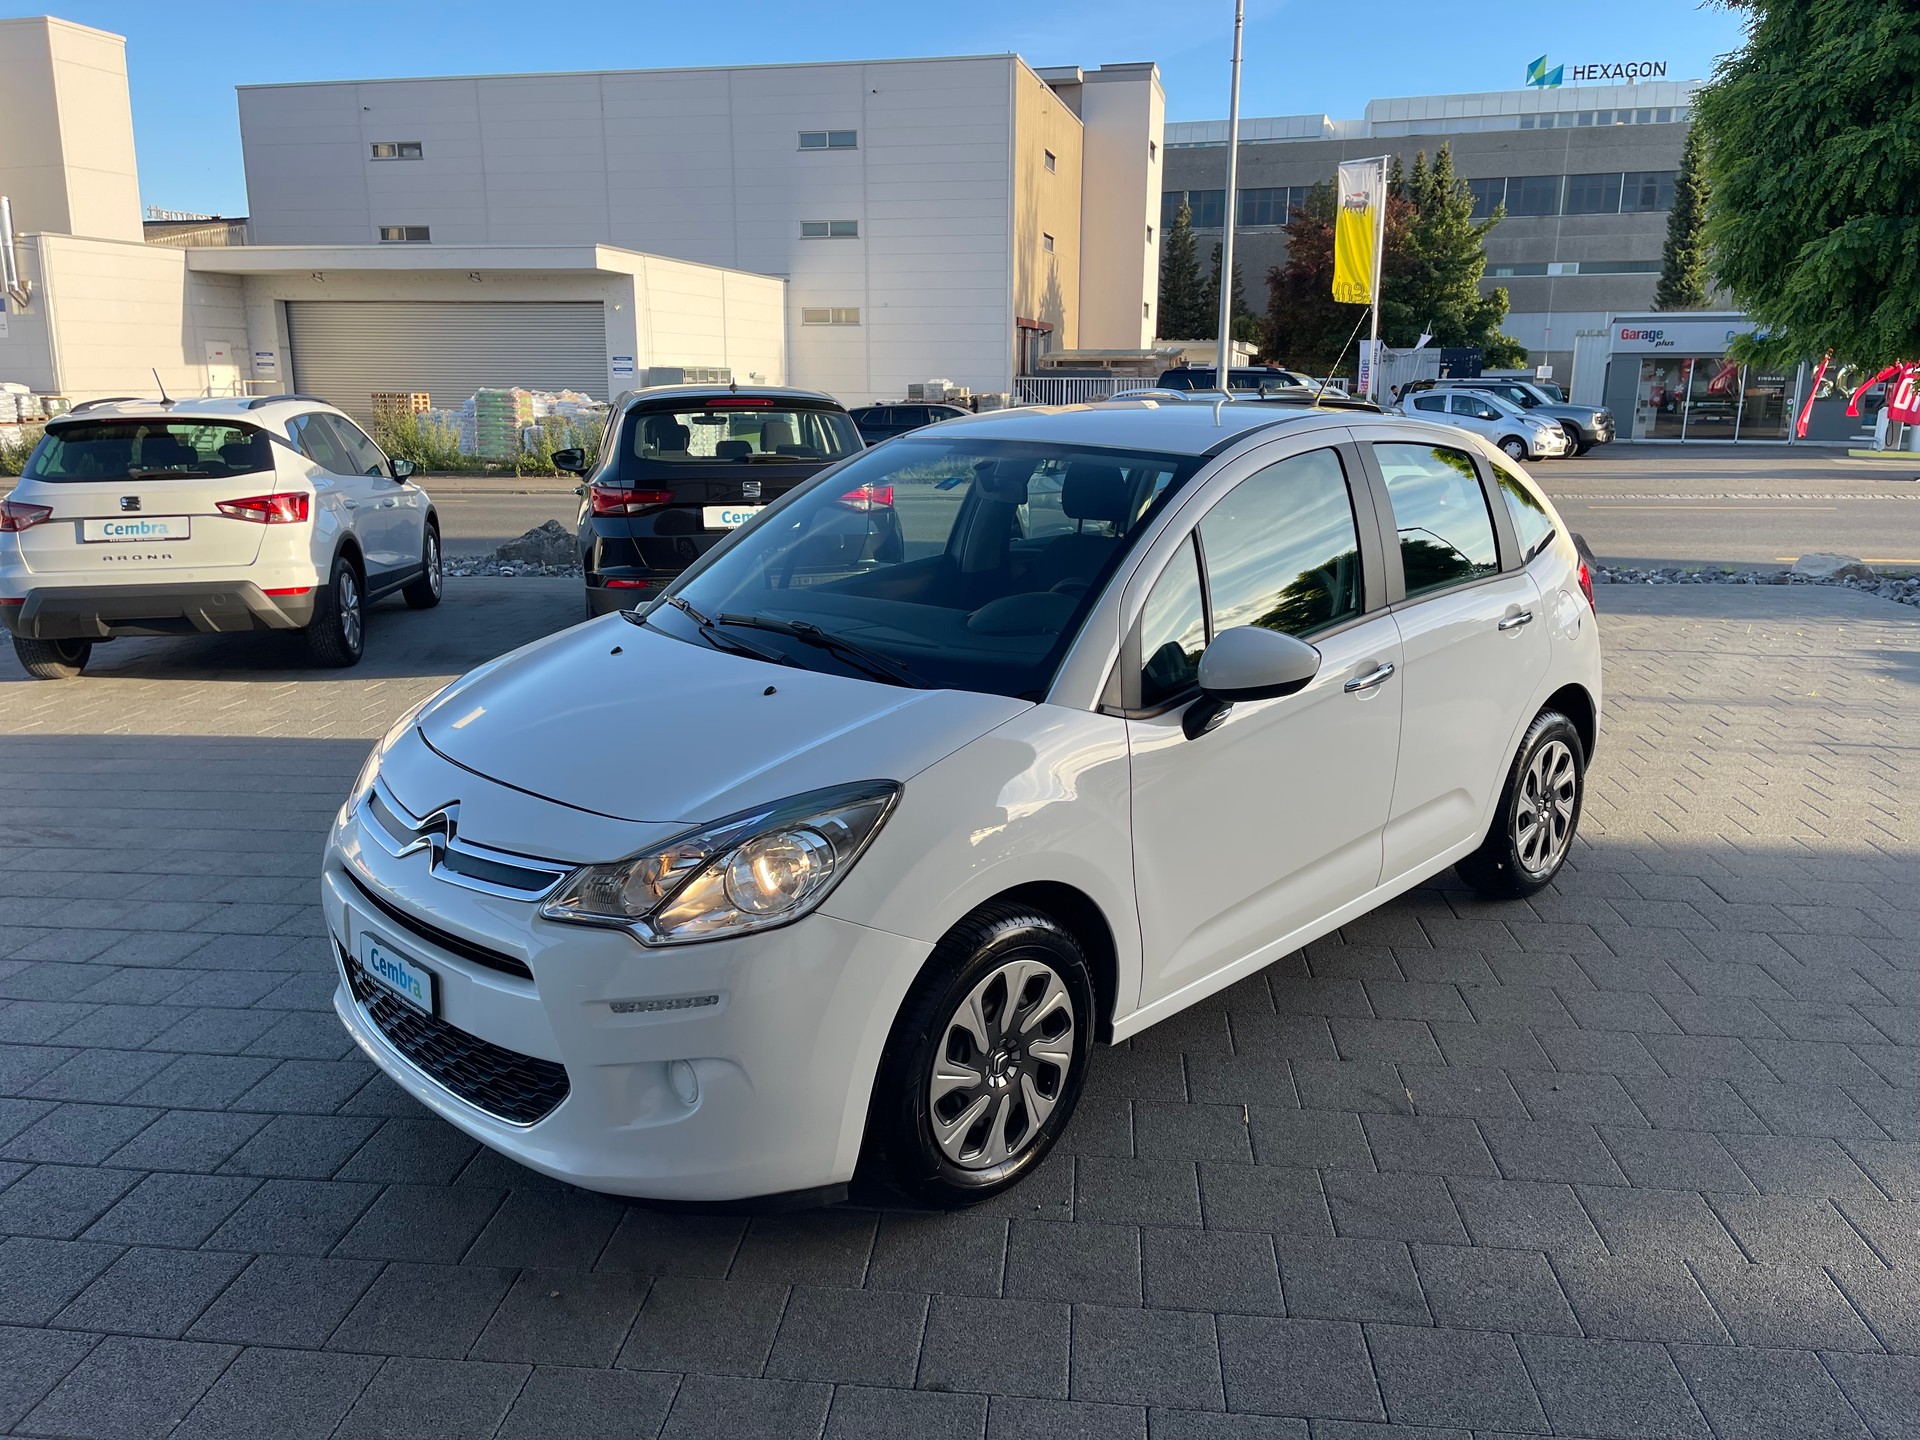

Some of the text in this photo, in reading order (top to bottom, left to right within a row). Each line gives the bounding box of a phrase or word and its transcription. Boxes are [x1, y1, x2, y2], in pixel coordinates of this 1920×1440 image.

[1573, 61, 1667, 80] HEXAGON
[1621, 328, 1664, 343] Garage
[1655, 340, 1675, 348] plus
[1360, 360, 1370, 394] arage
[721, 509, 761, 524] Cem
[103, 521, 169, 535] Cembra
[103, 553, 172, 561] ARONA
[371, 947, 422, 1000] Cembra
